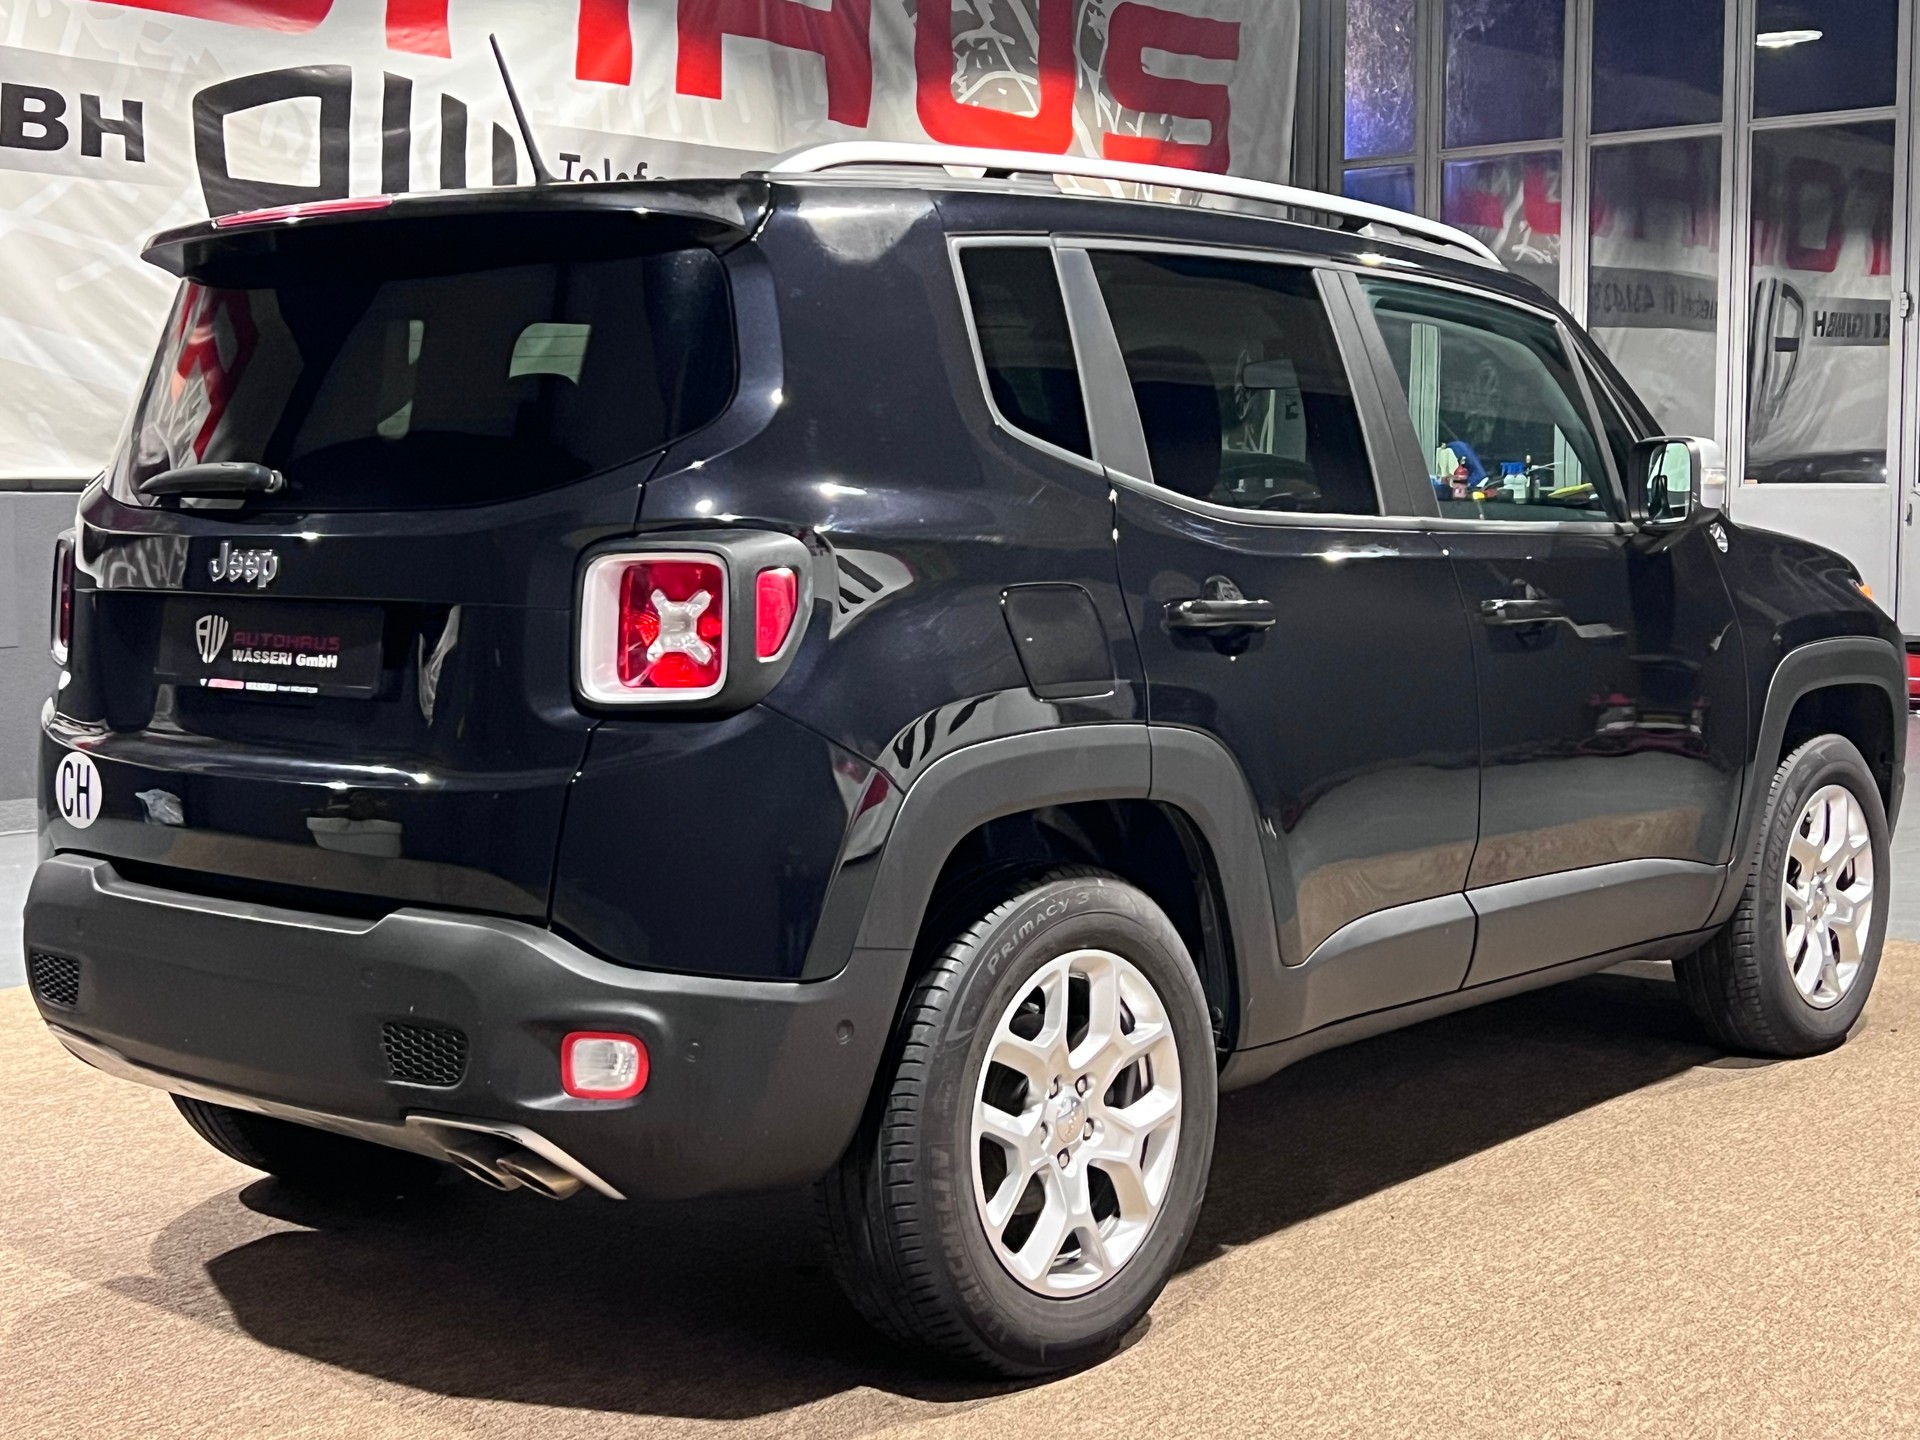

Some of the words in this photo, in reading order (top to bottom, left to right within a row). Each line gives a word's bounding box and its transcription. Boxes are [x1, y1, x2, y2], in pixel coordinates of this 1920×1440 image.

[0, 82, 146, 163] BH
[559, 152, 668, 182] Tlf
[207, 540, 278, 589] Jeep
[233, 631, 342, 650] AUTOHAUS
[295, 654, 338, 668] GmbH
[63, 760, 90, 819] CH
[987, 898, 1070, 976] PRIMACY
[1076, 892, 1090, 904] 3
